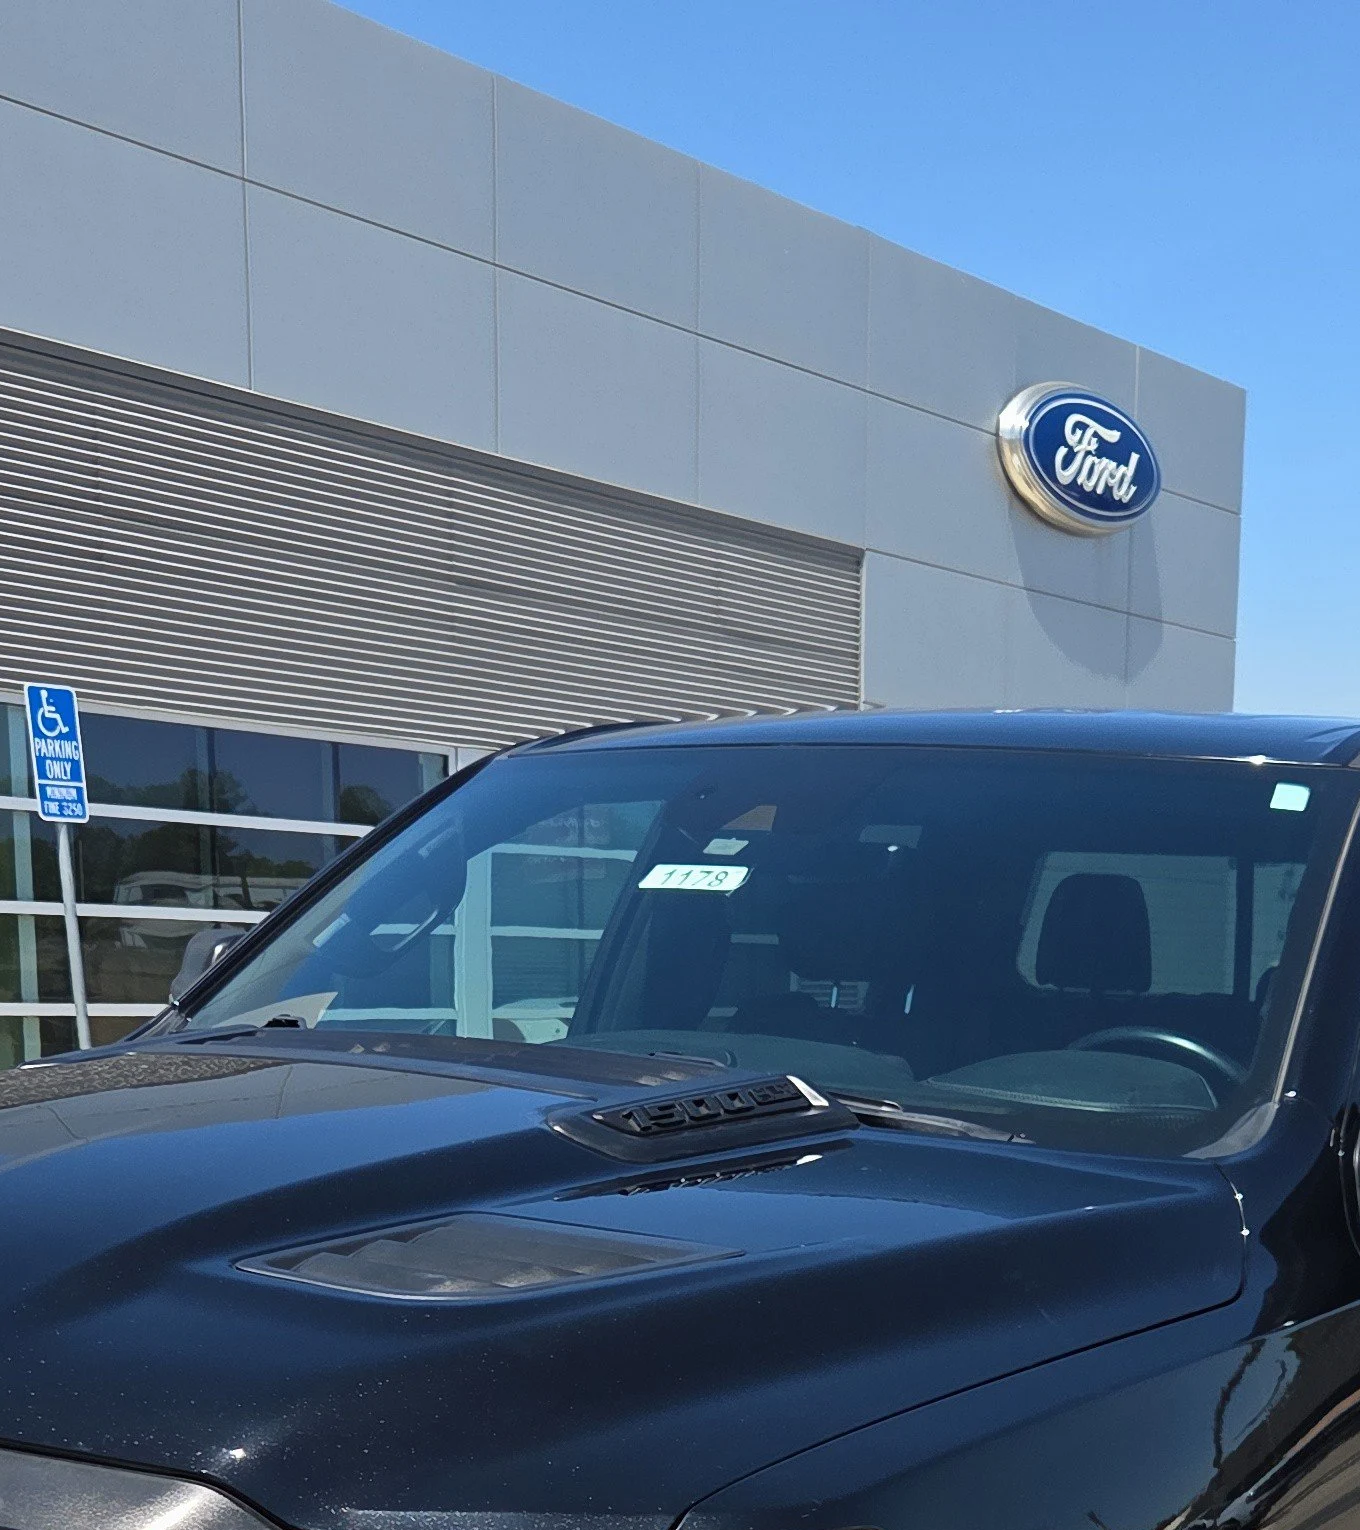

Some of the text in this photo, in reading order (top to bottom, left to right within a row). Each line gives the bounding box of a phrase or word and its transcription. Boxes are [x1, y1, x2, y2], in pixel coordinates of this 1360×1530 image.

[1055, 413, 1140, 504] Ford
[35, 737, 80, 759] PARKING
[45, 760, 72, 780] ONLY
[661, 868, 729, 888] 1178
[620, 1089, 757, 1132] 1500
